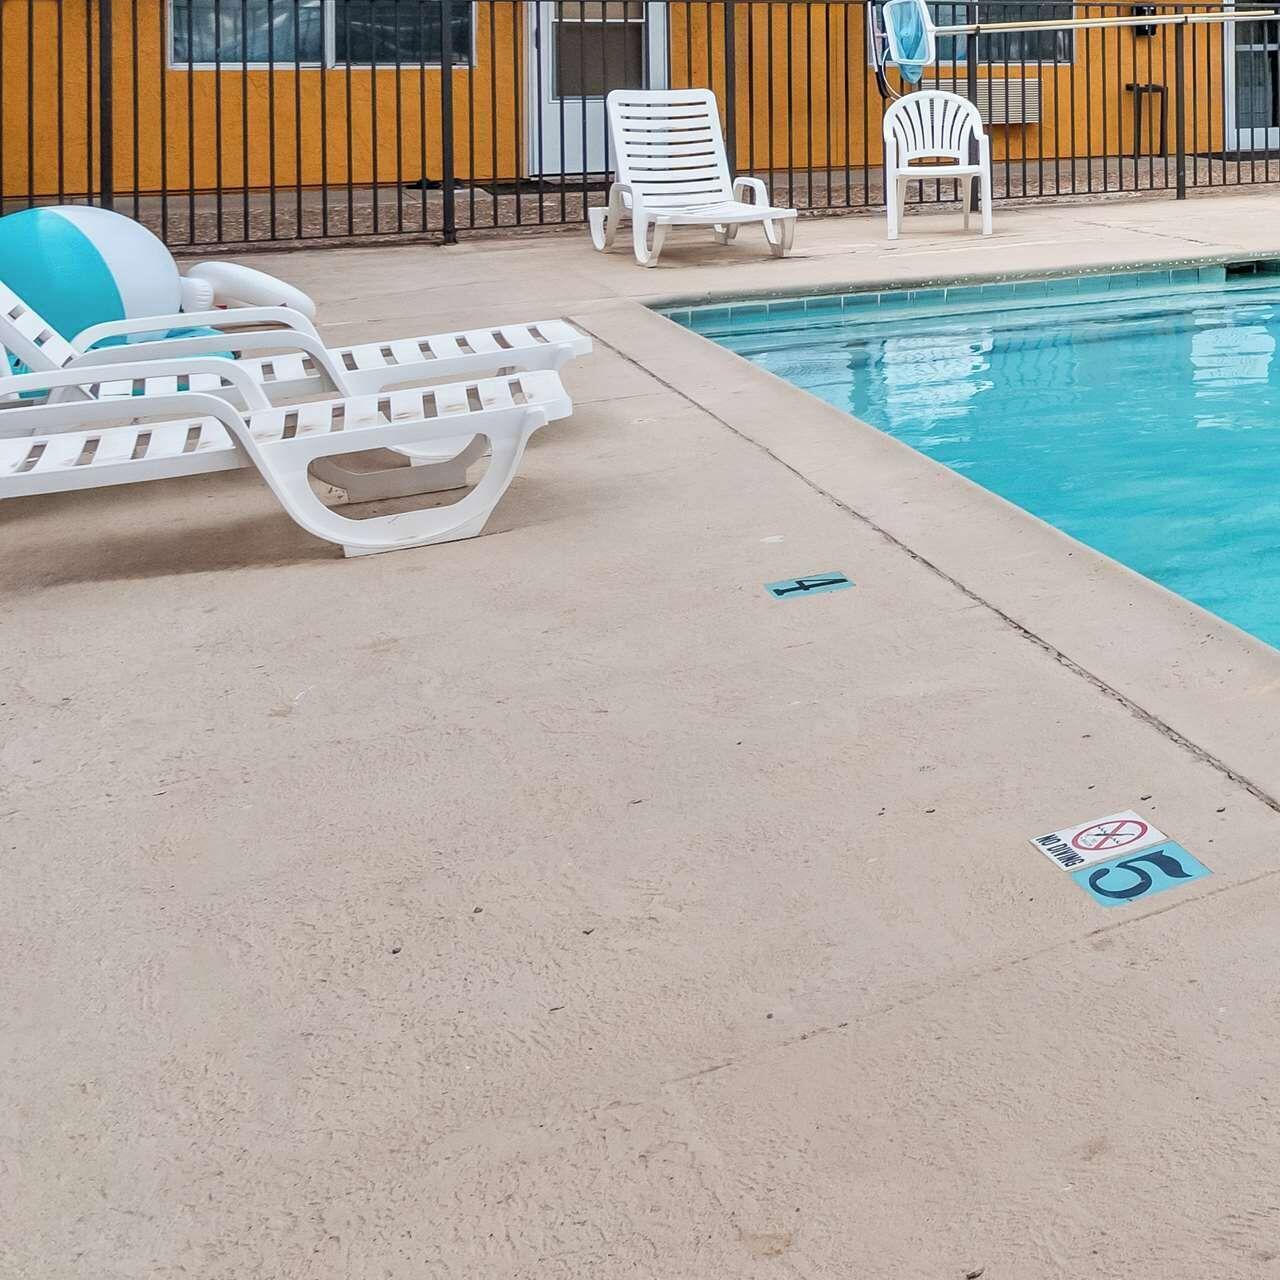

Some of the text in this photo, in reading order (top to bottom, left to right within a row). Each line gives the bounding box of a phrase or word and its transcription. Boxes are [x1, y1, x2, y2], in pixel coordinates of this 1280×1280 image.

[772, 578, 849, 597] 4
[1035, 833, 1085, 868] NO DIVING
[1088, 849, 1193, 899] 5
